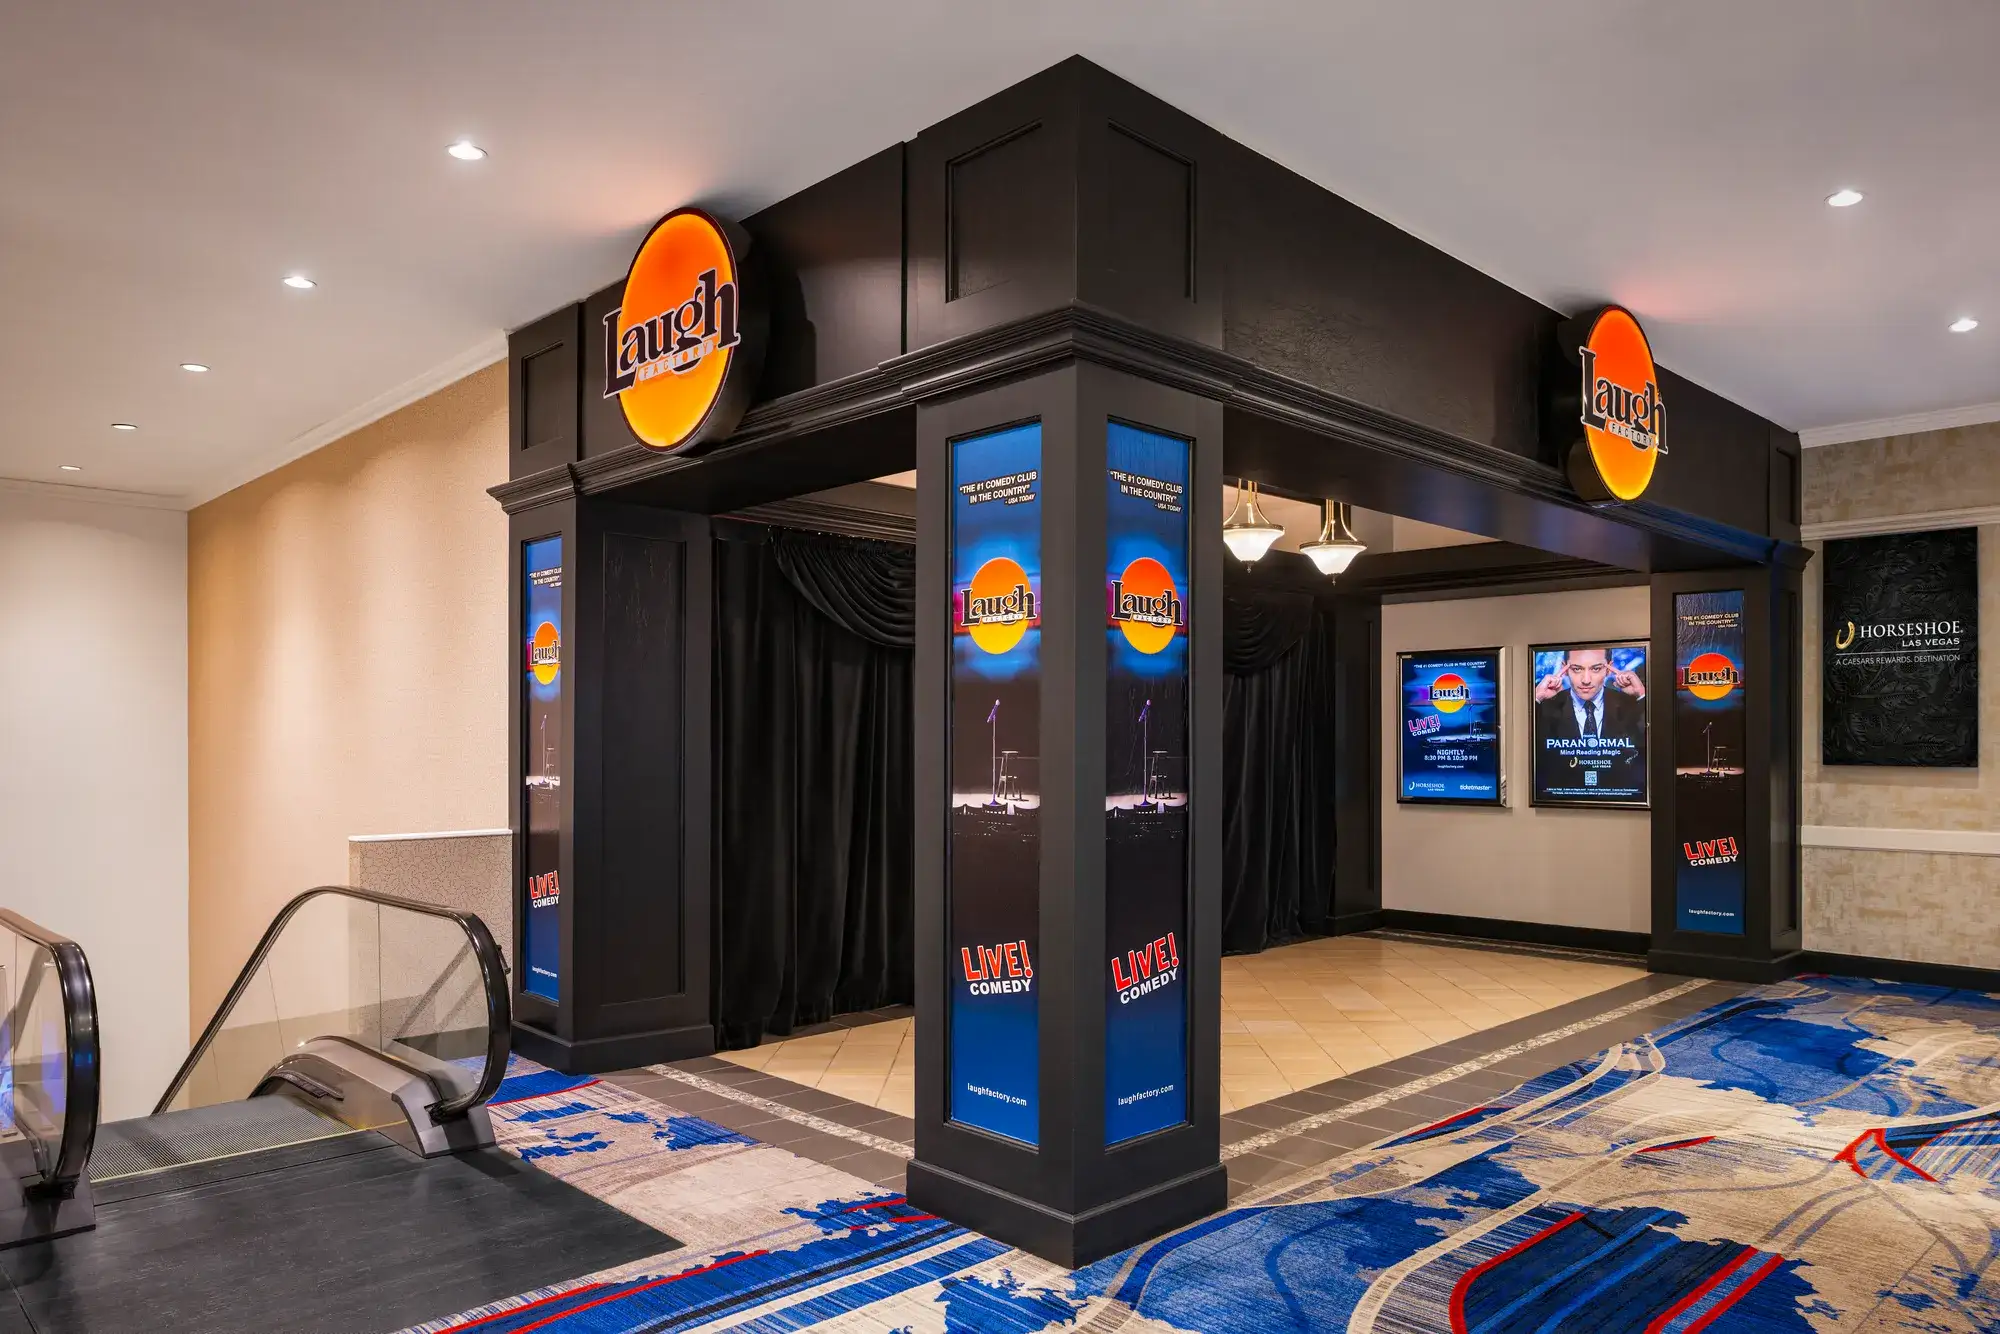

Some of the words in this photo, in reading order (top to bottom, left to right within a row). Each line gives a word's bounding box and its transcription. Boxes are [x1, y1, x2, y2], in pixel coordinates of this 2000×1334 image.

[603, 267, 741, 399] Laugh
[642, 341, 711, 379] FACTORY
[1579, 346, 1668, 454] Laugh
[1611, 422, 1653, 447] FACTORY
[977, 482, 984, 491] #1
[985, 475, 1016, 489] COMEDY
[1017, 471, 1037, 483] CLUB
[1121, 484, 1128, 493] IN
[1129, 486, 1143, 497] THE
[1127, 475, 1135, 483] #1
[1136, 476, 1165, 490] COMEDY
[1165, 483, 1183, 494] CLUB
[970, 495, 977, 504] IN
[978, 492, 992, 502] THE
[1019, 493, 1036, 502] TODAY
[1167, 504, 1182, 512] TODAY
[961, 584, 1037, 626] Laugh
[1111, 580, 1183, 626] Laugh
[1902, 639, 1922, 647] LAS
[1925, 637, 1960, 646] VEGAS
[530, 640, 561, 666] Laugh
[1843, 657, 1874, 666] CAESARS
[1914, 654, 1960, 663] DESTINATION
[1682, 666, 1740, 686] Laugh
[1427, 684, 1471, 701] Laugh
[1408, 714, 1441, 732] LIVE!
[1412, 726, 1440, 737] COMEDY
[1546, 737, 1635, 749] PARANORMAL
[1683, 836, 1739, 860] LIVE!
[1690, 855, 1737, 867] COMEDY
[529, 870, 560, 900] LIVE!
[532, 895, 560, 909] COMEDY
[1688, 908, 1735, 917] laughfactory.com
[961, 939, 1033, 982] LIVE!
[1111, 931, 1179, 993] LIVE!
[970, 978, 1032, 995] COMEDY
[1120, 968, 1178, 1005] COMEDY
[967, 1083, 1027, 1107] laughfactory.com
[1118, 1084, 1174, 1106] laughfactory.com
